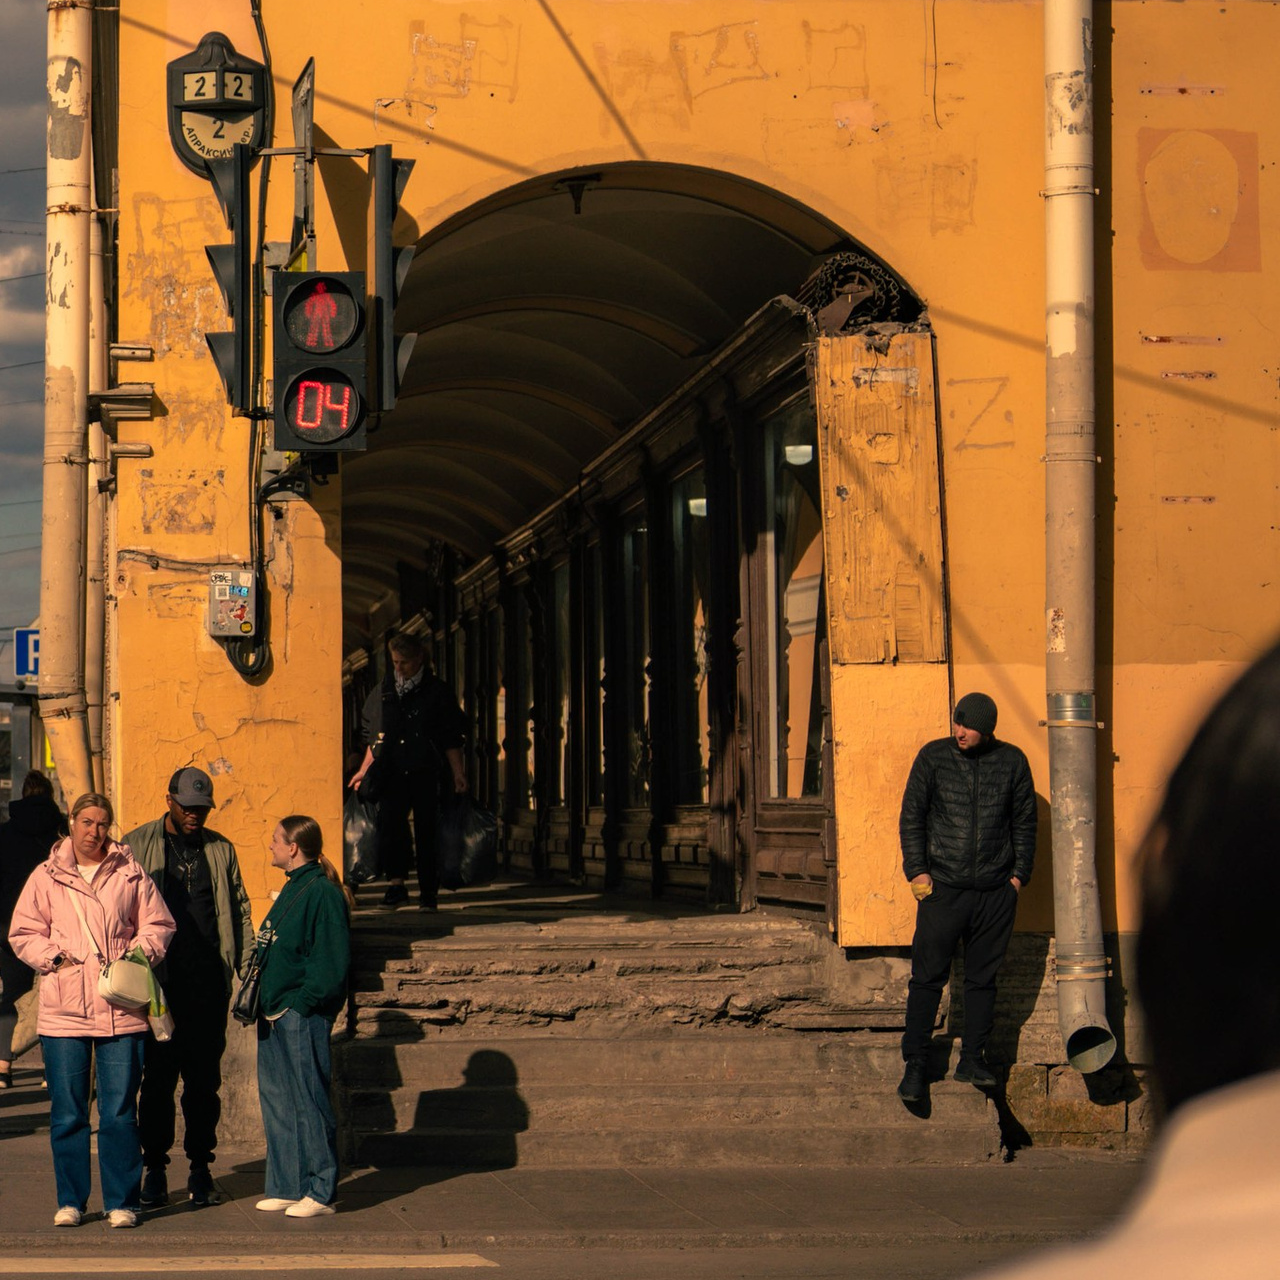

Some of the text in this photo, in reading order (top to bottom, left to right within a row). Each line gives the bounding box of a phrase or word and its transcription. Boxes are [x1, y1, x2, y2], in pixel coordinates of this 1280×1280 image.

[194, 76, 205, 96] 2
[233, 75, 242, 96] 2
[212, 119, 224, 138] 2
[186, 127, 234, 158] АПРАКСИН
[296, 381, 350, 429] 04
